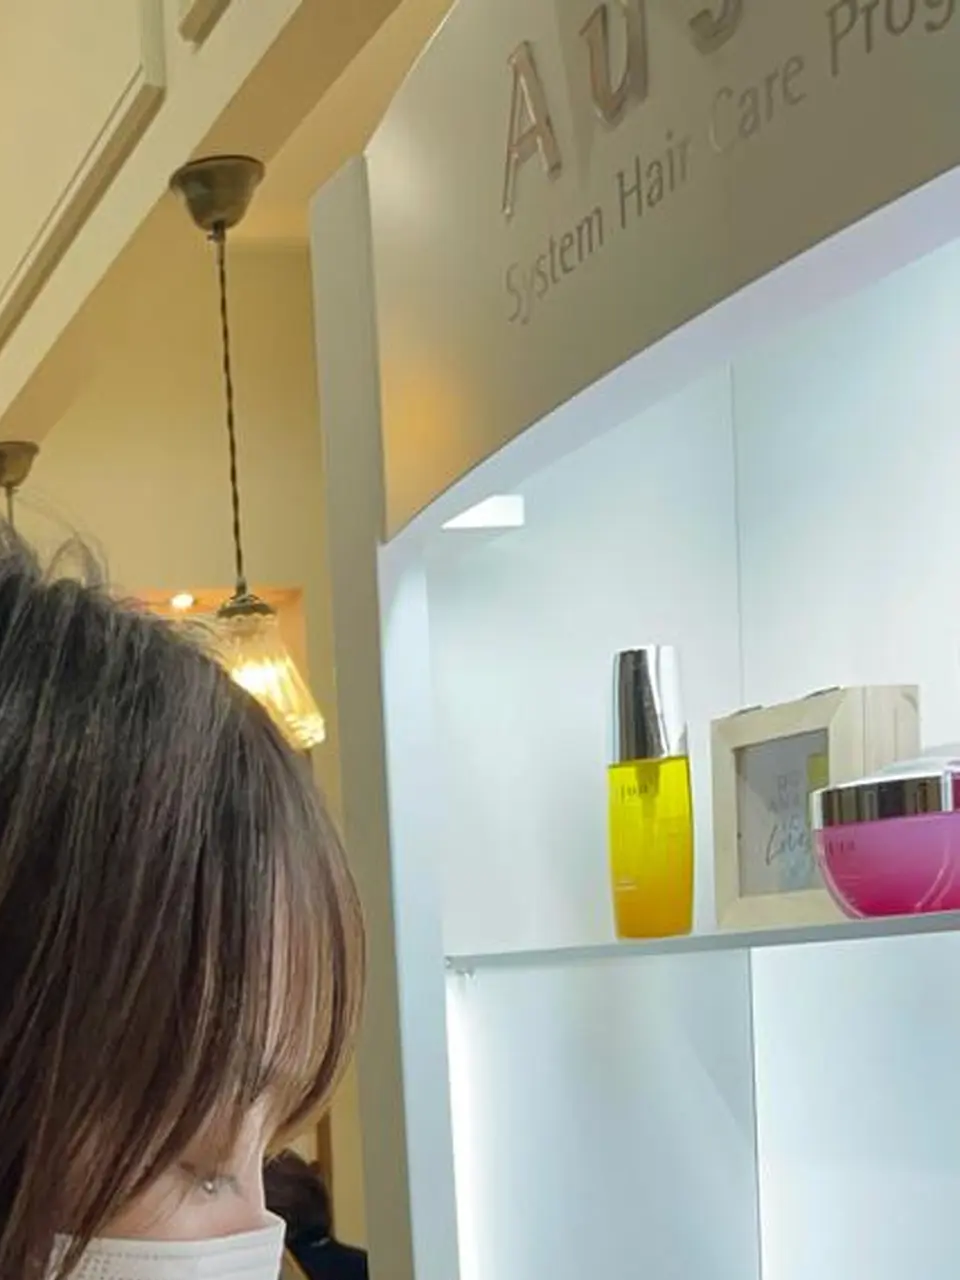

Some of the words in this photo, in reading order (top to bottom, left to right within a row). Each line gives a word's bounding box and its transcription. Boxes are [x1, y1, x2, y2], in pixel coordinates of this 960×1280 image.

[505, 205, 605, 325] System
[616, 129, 690, 230] Hair
[708, 54, 808, 155] Care
